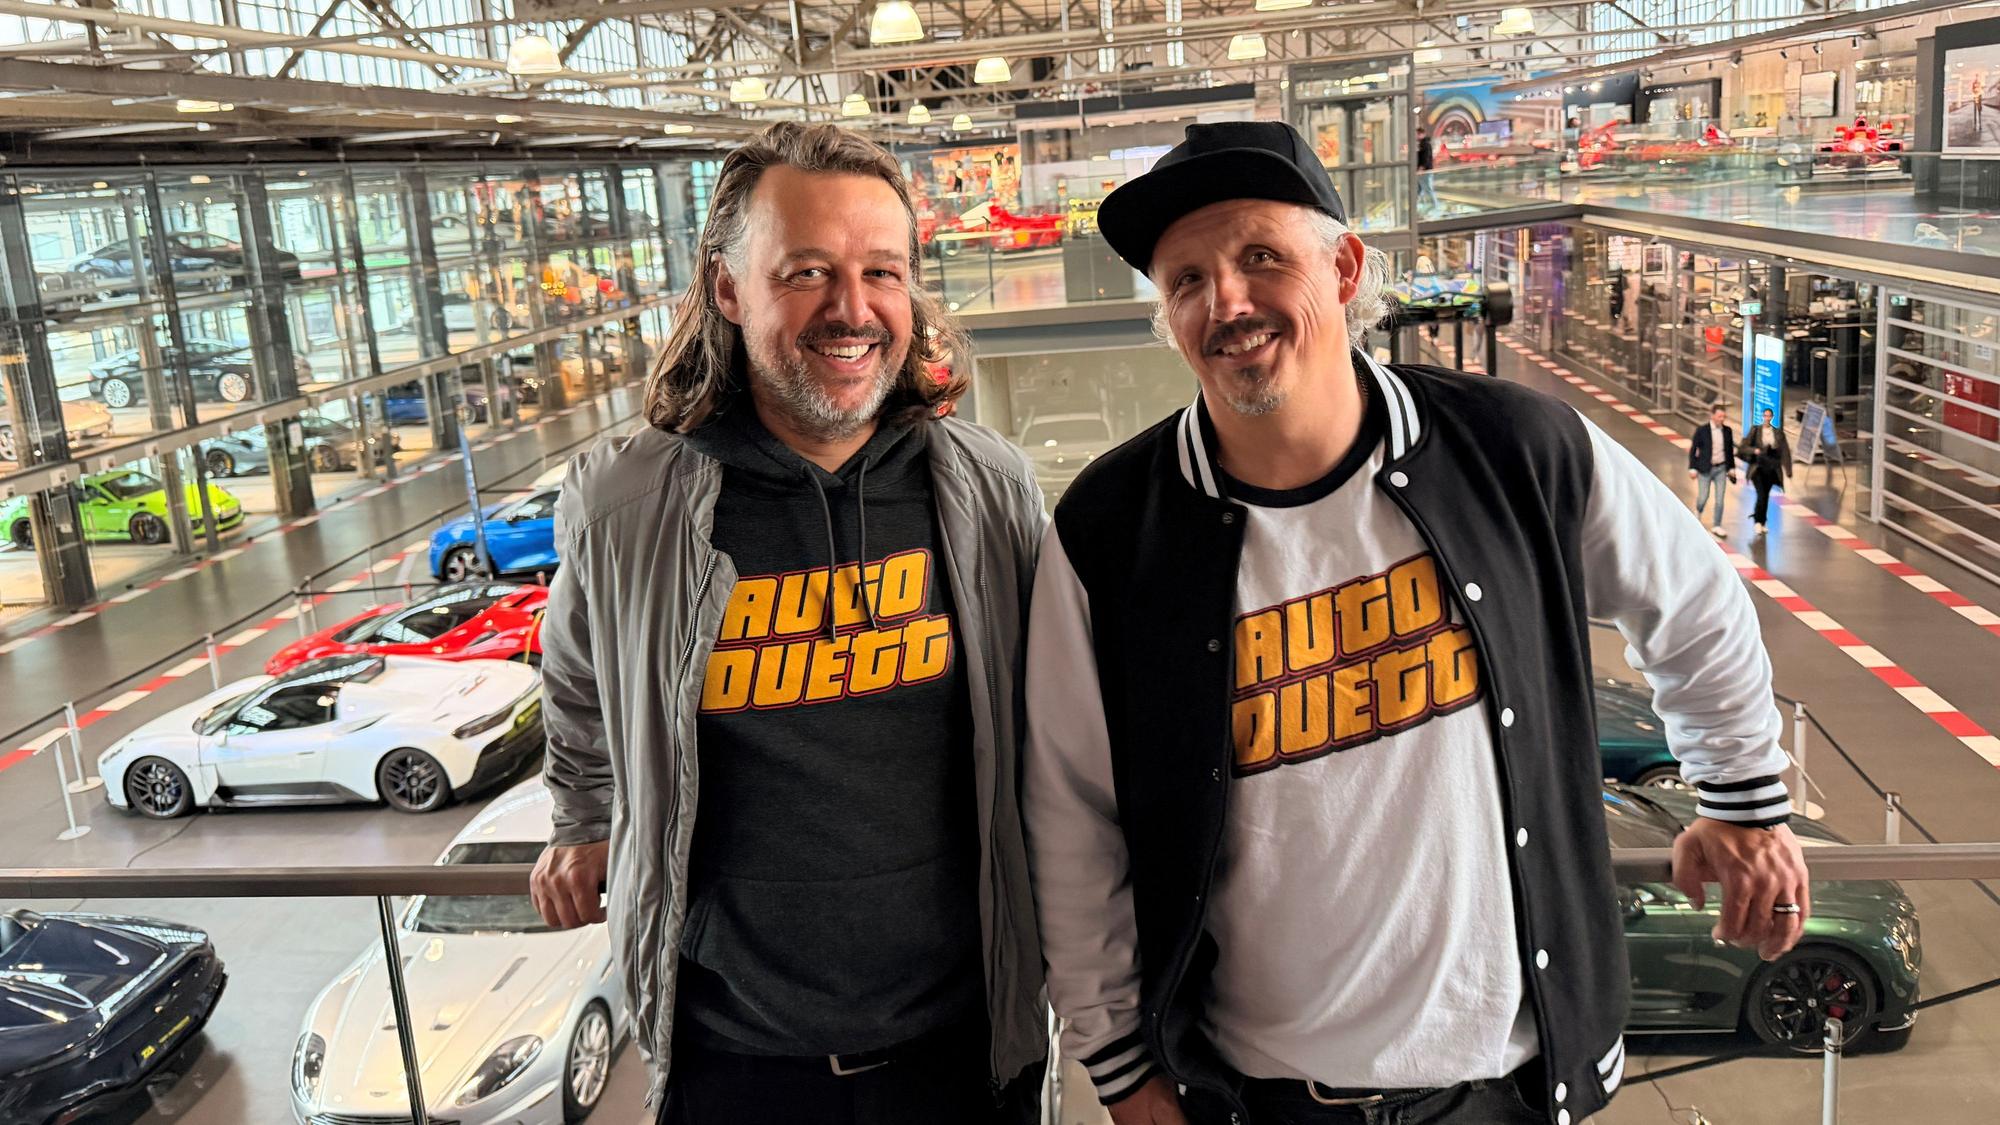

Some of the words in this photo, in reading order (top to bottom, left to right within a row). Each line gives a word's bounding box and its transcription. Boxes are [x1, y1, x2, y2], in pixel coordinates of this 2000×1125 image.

[717, 549, 932, 642] AUTO
[1233, 552, 1447, 691] AUTO
[699, 614, 951, 713] DUETT
[1231, 625, 1482, 770] DUETT
